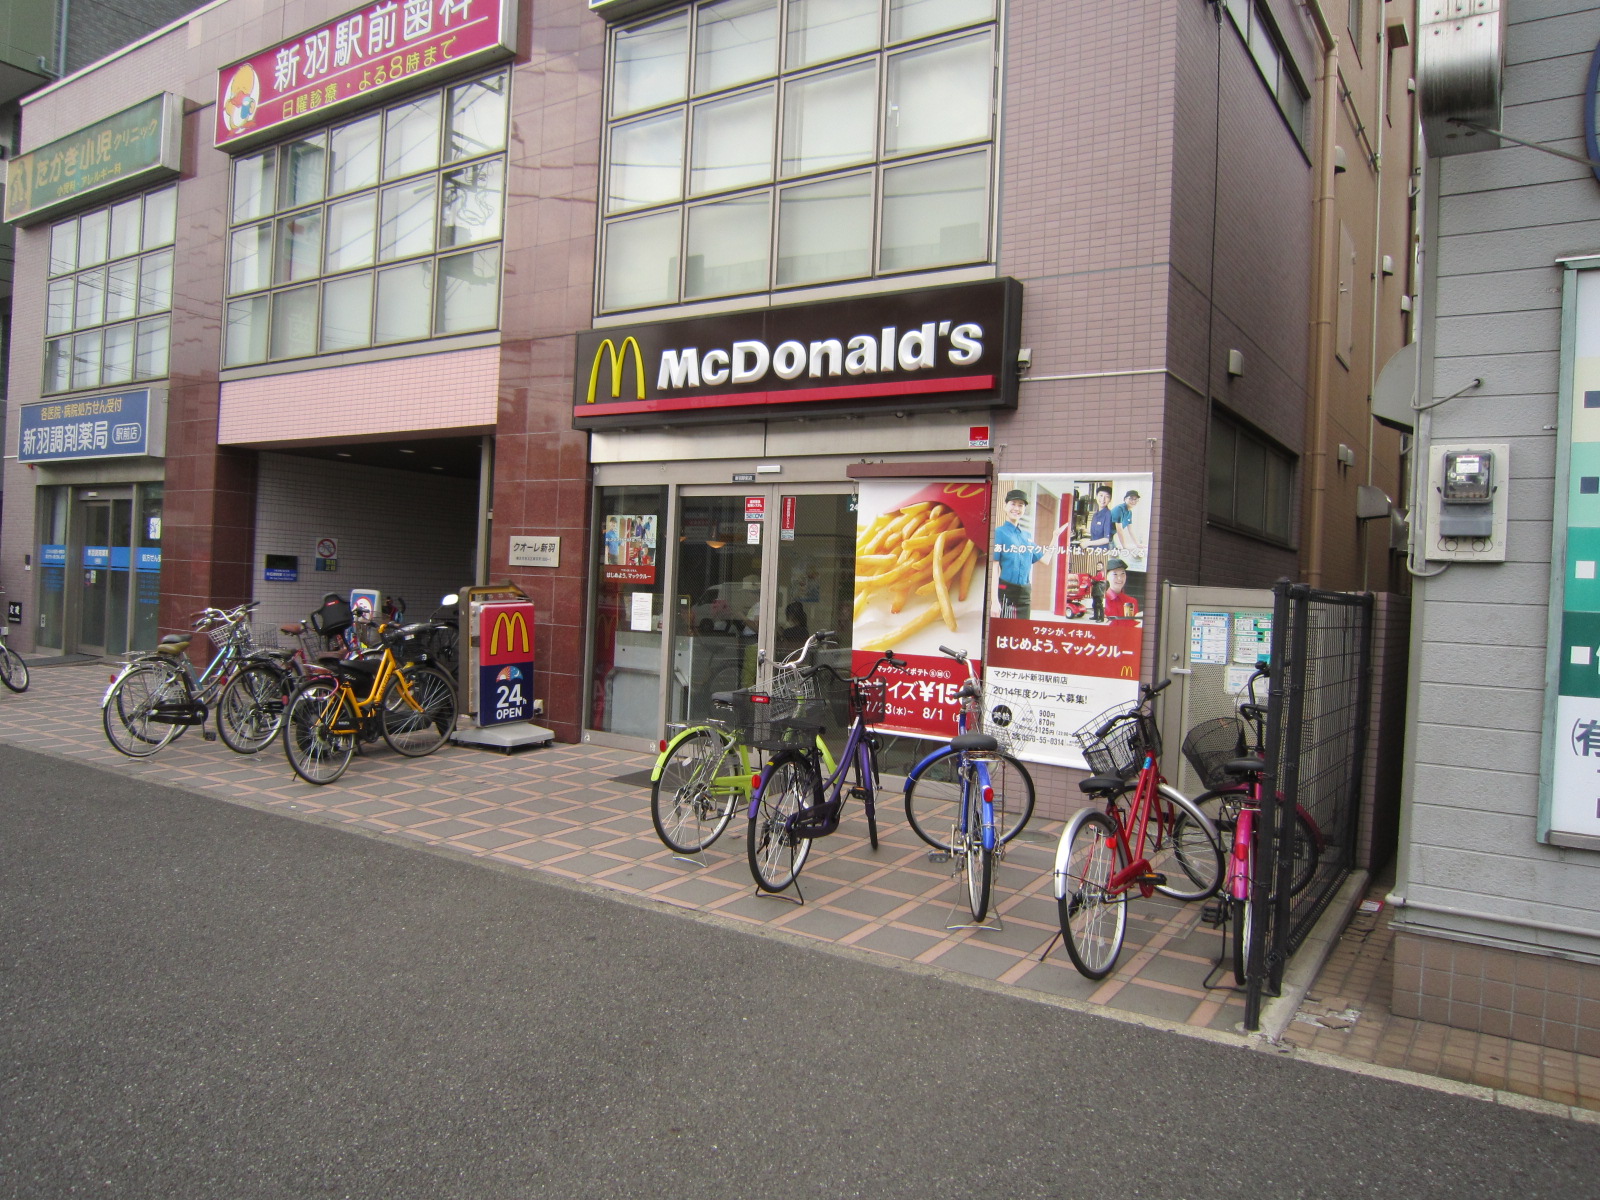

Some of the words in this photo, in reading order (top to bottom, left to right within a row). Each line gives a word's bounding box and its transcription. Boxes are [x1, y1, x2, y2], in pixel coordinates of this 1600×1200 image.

[656, 320, 985, 391] McDonald's
[22, 420, 109, 456] 新羽調剤薬局
[115, 426, 138, 442] 駅前店
[513, 542, 557, 554] クオーレ新羽
[495, 708, 523, 721] OPEN
